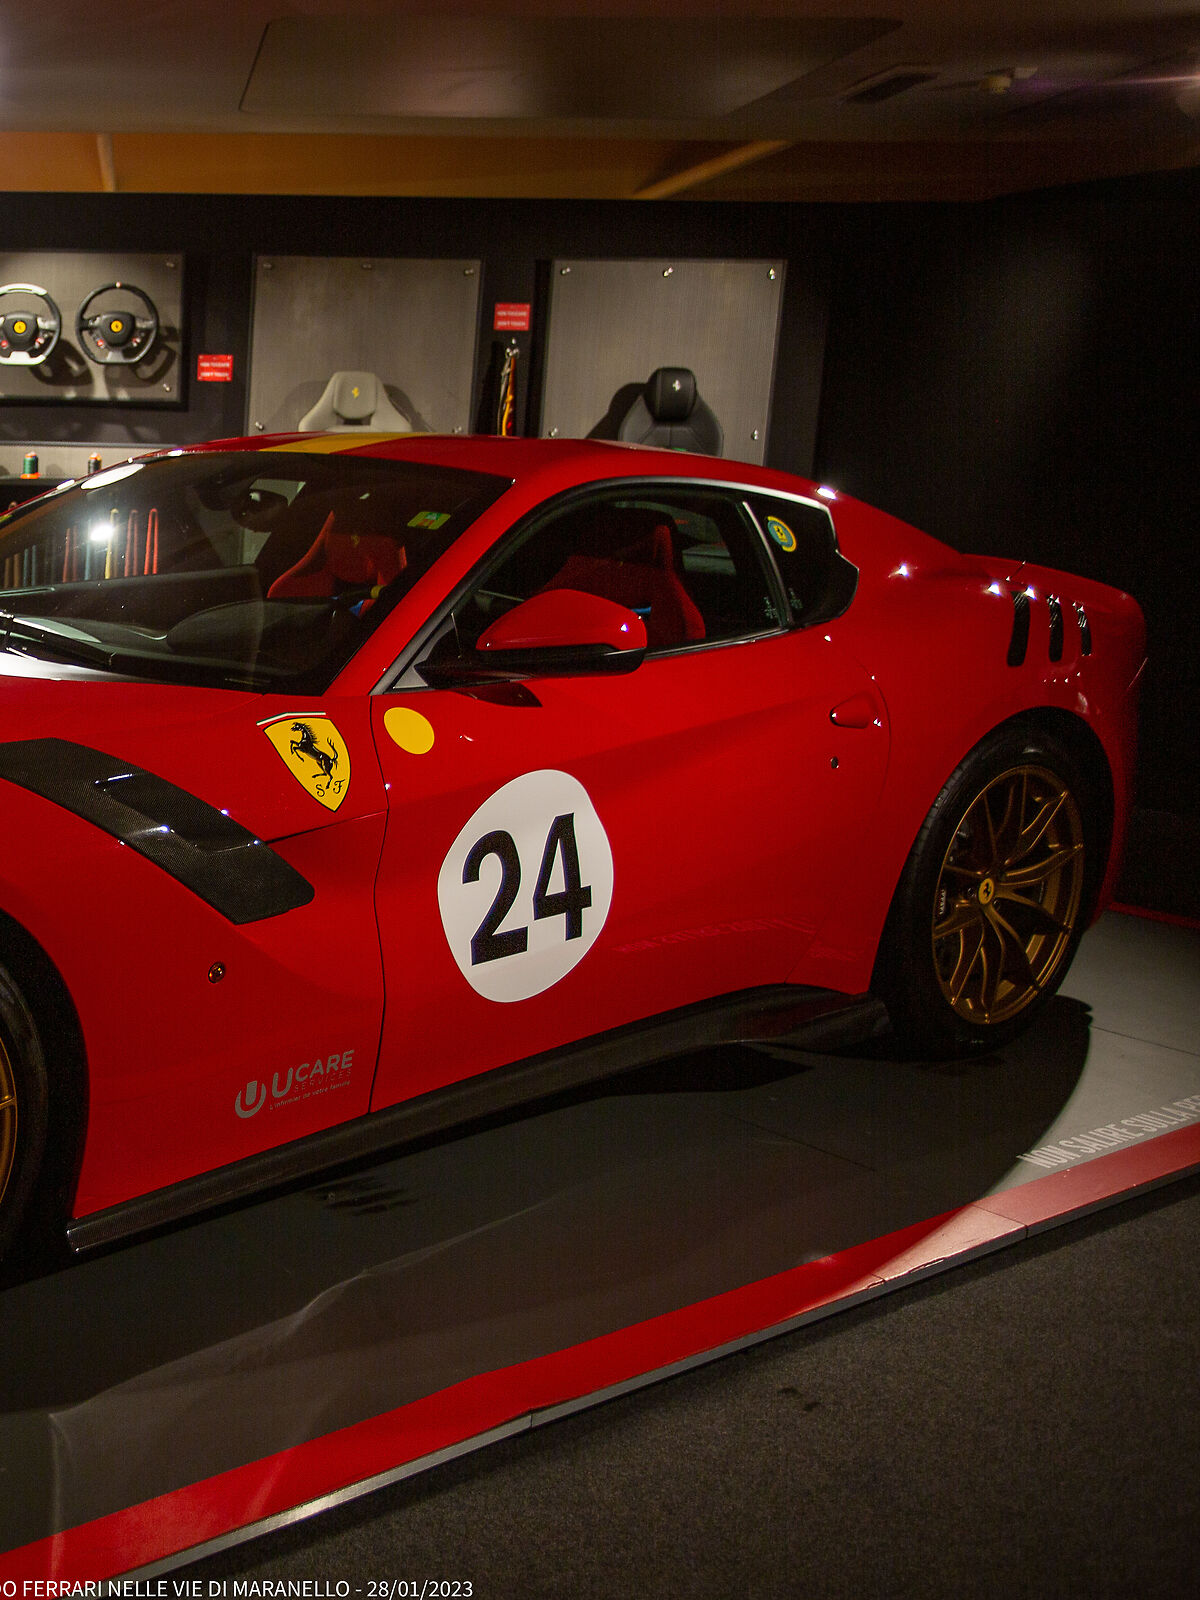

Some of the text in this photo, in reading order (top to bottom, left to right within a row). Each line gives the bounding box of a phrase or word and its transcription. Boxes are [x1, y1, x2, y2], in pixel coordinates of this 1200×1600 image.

[462, 812, 593, 966] 24
[1016, 1106, 1198, 1168] NON SALIRE SULLA
